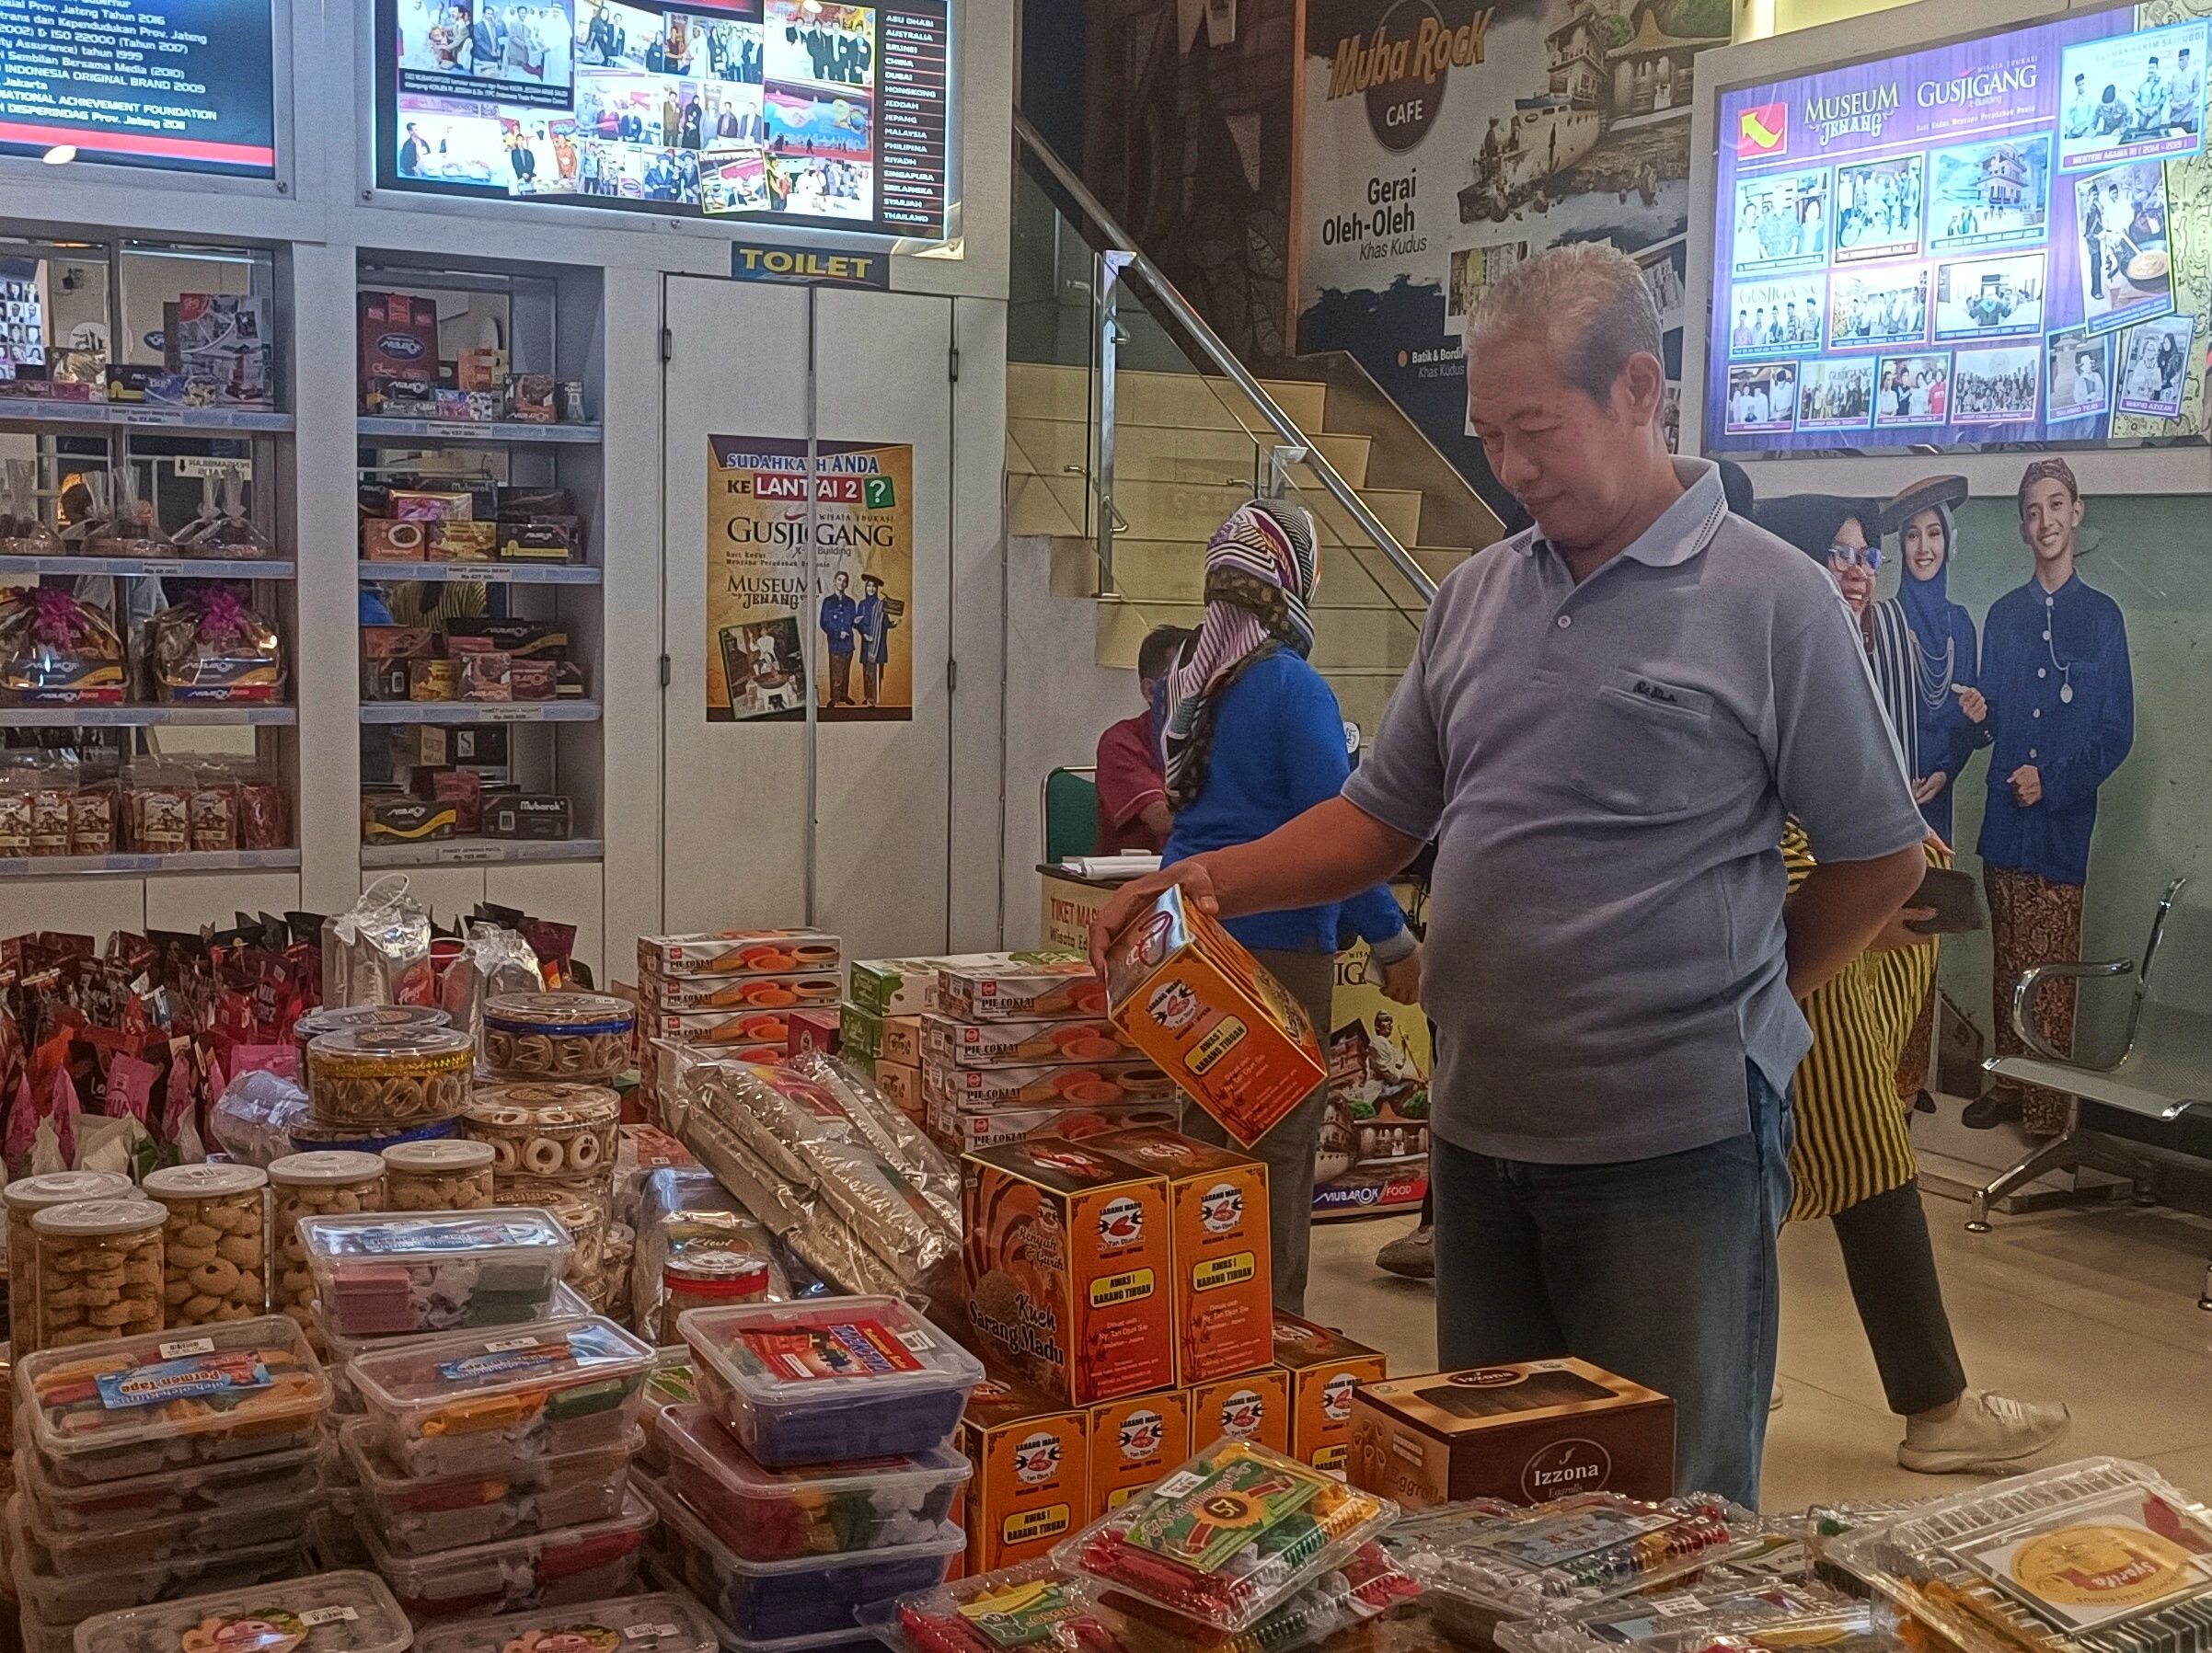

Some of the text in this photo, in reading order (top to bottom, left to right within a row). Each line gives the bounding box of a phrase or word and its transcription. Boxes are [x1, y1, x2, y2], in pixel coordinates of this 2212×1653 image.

[29, 1, 58, 13] Prov.
[61, 5, 98, 18] Jateng
[101, 9, 135, 21] Tahun
[0, 11, 208, 45] trans dan Kependudukan Prov. Jateng
[886, 15, 934, 28] ABU DHABI
[0, 23, 34, 37] 2002)
[51, 29, 72, 40] ISO
[75, 32, 116, 45] 22000
[119, 38, 156, 50] (Tahun
[886, 29, 933, 42] AUSTRALIA
[16, 39, 144, 61] Assurance) tahun 1999
[886, 43, 918, 54] BRUNEI
[7, 52, 184, 80] Sembilan Bersama Media (2010)
[885, 57, 914, 68] CHINA
[1327, 26, 1410, 101] Muba
[3, 77, 49, 90] Jakarta
[5, 64, 206, 94] INDONESIA ORIGINAL BRAND 2009
[885, 71, 913, 82] DUBAI
[885, 86, 937, 98] HONGKONG
[1916, 64, 2039, 108] GUSJIGANG
[0, 89, 217, 121] NATIONAL ACHIEVEMENT FOUNDATION
[884, 99, 919, 110] JEDDAH
[1803, 82, 1900, 124] MUSEUM
[7, 103, 161, 130] DISPERINDAG Prov. Jateng
[884, 114, 917, 124] JEPANG
[1386, 98, 1423, 127] CAFE
[884, 128, 927, 140] MALAYSIA
[1820, 112, 1883, 146] JENANG
[884, 142, 927, 153] PHILIPINA
[2103, 150, 2128, 161] AGAMA
[884, 155, 917, 166] RIYADH
[883, 170, 935, 181] SINGAPURA
[1367, 167, 1417, 206] Gerai
[883, 198, 923, 208] SYARJAH
[883, 212, 929, 223] THAILAND
[1322, 202, 1415, 246] Oleh-Oleh
[1359, 235, 1427, 261] Khas Kudus
[739, 248, 873, 279] TOILET
[1411, 350, 1433, 364] Batik
[1433, 350, 1439, 362] &
[1418, 364, 1465, 378] Khas Kudus
[831, 455, 881, 475] ANDA
[727, 480, 752, 494] KE
[755, 476, 838, 498] LANTAI
[845, 480, 858, 499] 2
[727, 516, 894, 551] GUSJIGANG
[727, 575, 824, 595] MUSEUM
[743, 592, 800, 610] JENANG
[520, 800, 562, 812] Mubarok
[1050, 897, 1100, 929] TIKET MAS
[1049, 926, 1089, 951] Wisata Ed
[1348, 951, 1370, 959] WISA
[981, 995, 1036, 1009] PIE COKLAT
[1145, 978, 1182, 1014] SARANG MADU
[963, 1041, 1020, 1055] PIE COKLAT
[1195, 1026, 1246, 1073] BARANG TIRUAN
[1199, 1032, 1221, 1054] AWAS
[966, 1087, 1021, 1100] PIE COKLAT
[974, 1132, 1028, 1146] PIE COKLAT
[1201, 1188, 1242, 1203] SARANG MADU
[1387, 1185, 1412, 1197] FOOD
[1100, 1201, 1143, 1216] SARANG MADU
[1017, 1223, 1058, 1252] Renyah
[1036, 1251, 1066, 1272] Gurih
[1212, 1258, 1232, 1272] AWAS
[1110, 1276, 1132, 1289] AWAS
[1196, 1267, 1252, 1290] BARANG TIRUAN
[1093, 1283, 1151, 1305] BARANG TIRUAN
[1015, 1292, 1058, 1334] Kueh
[969, 1301, 1066, 1368] Sarang Madu
[120, 1370, 222, 1395] Permen Tape
[1323, 1381, 1346, 1391] SARANG
[1457, 1370, 1513, 1385] Izzona
[1222, 1394, 1263, 1408] SARANG MADU
[1120, 1414, 1163, 1428] SARANG MADU
[1015, 1437, 1061, 1452] SARANG MADU
[1533, 1464, 1599, 1487] Izzona
[1548, 1485, 1584, 1499] Eggrolls
[1023, 1511, 1046, 1524] AWAS
[1007, 1520, 1066, 1542] BARANG TIRUAN
[2090, 1560, 2155, 1591] Syarifa
